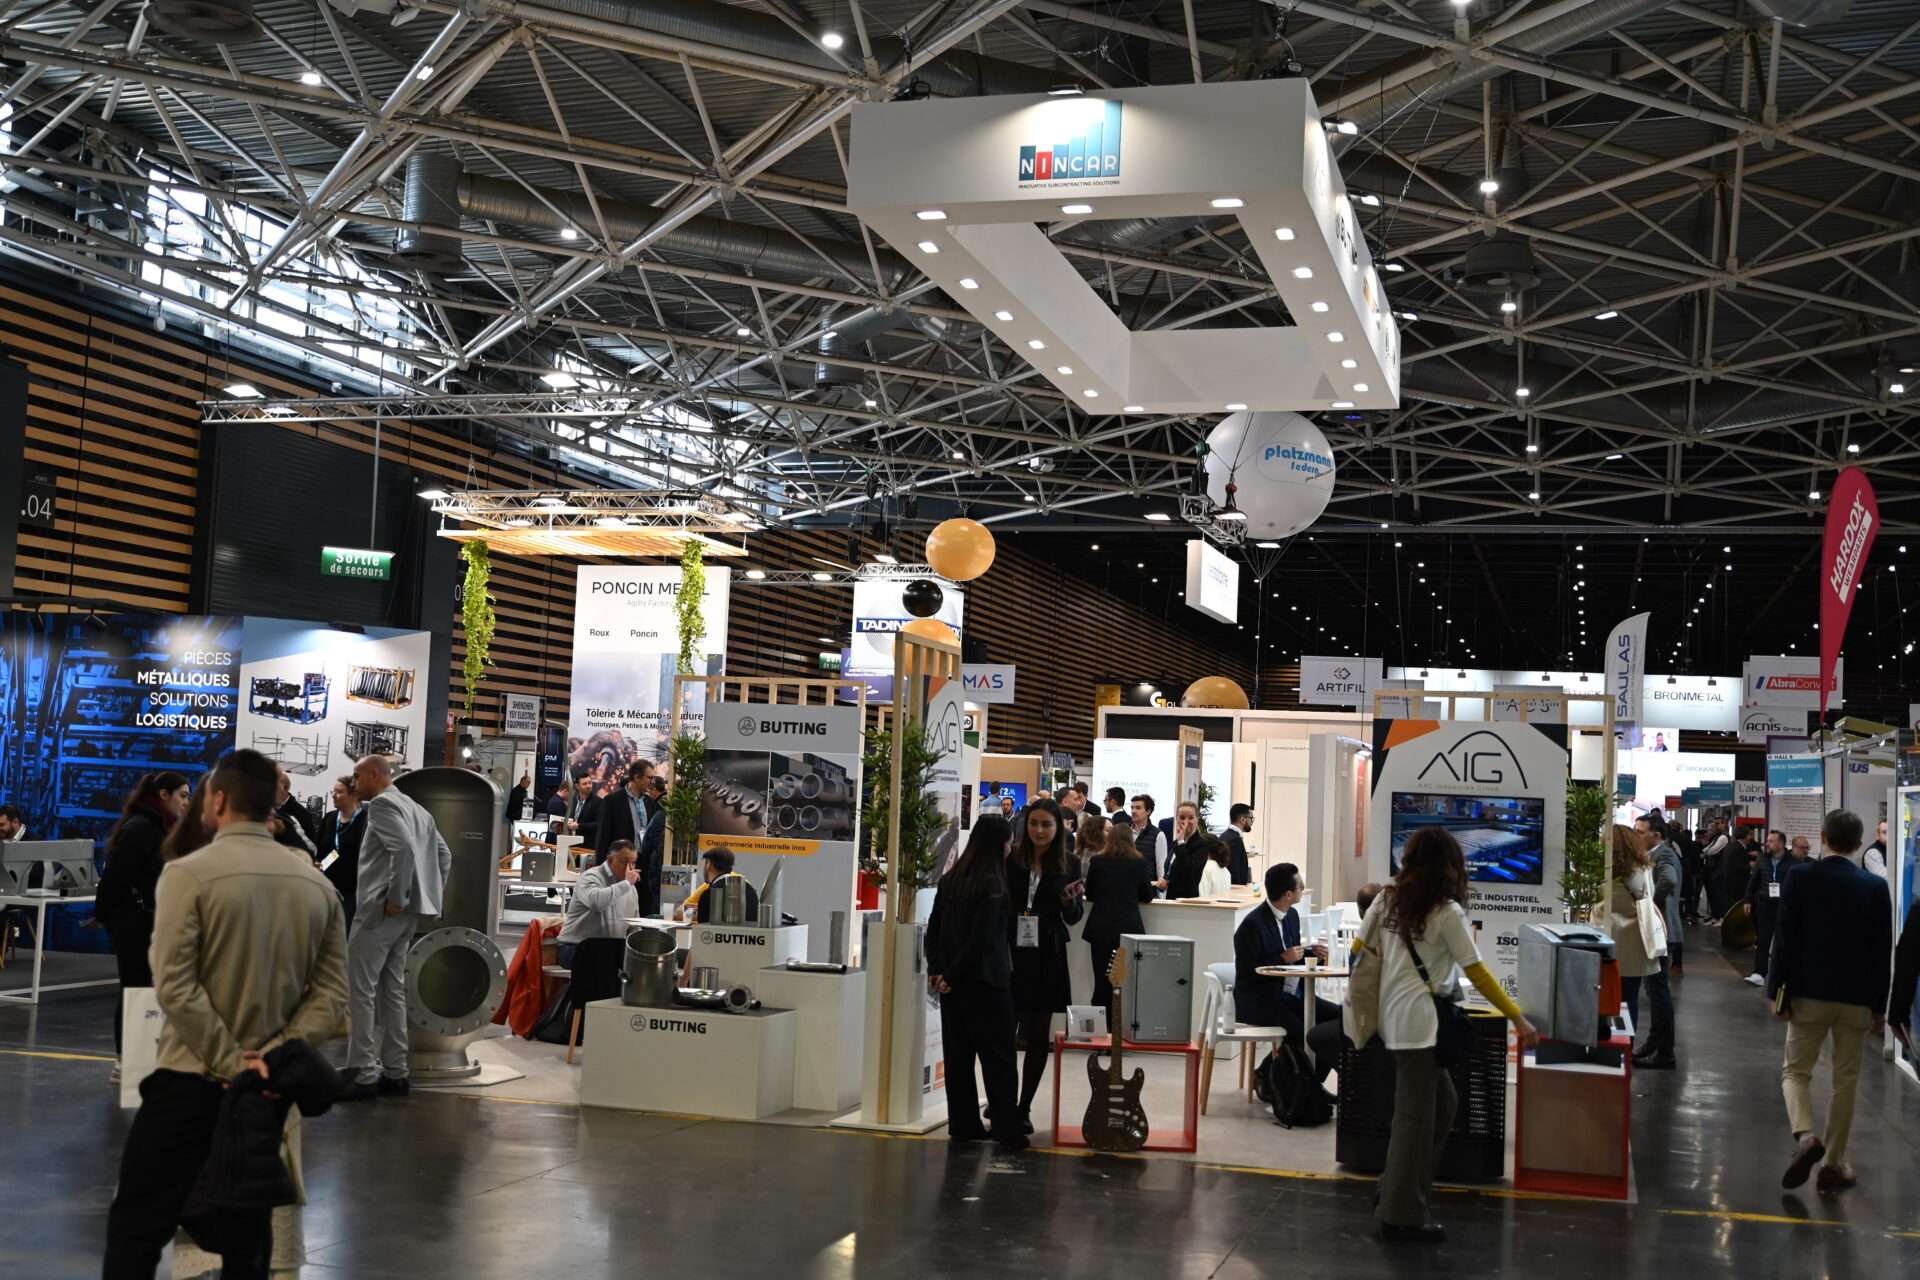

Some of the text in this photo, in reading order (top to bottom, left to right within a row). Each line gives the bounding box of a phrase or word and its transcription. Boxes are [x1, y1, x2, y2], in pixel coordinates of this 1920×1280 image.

[1020, 155, 1118, 175] NINCAR
[1264, 445, 1332, 466] platzmann
[1830, 489, 1865, 593] HARDOX
[335, 551, 380, 566] Sortie
[330, 563, 384, 577] de secours
[592, 581, 710, 596] PONCIN MEL
[589, 629, 658, 638] Roux Poncin
[184, 649, 232, 665] PIÈCES
[137, 669, 230, 688] MÉTALLIQUES
[1616, 634, 1631, 718] SAULAS
[1316, 682, 1367, 693] ARTIFIL
[150, 692, 229, 708] SOLUTIONS
[1654, 690, 1724, 702] BRONMETAL
[618, 709, 624, 719] &
[136, 713, 227, 731] LOGISTIQUES
[759, 720, 828, 736] BUTTING
[1484, 893, 1540, 903] INDUSTRIEL
[1530, 906, 1553, 914] FINE
[714, 933, 766, 946] BUTTING
[649, 1018, 707, 1034] BUTTING
